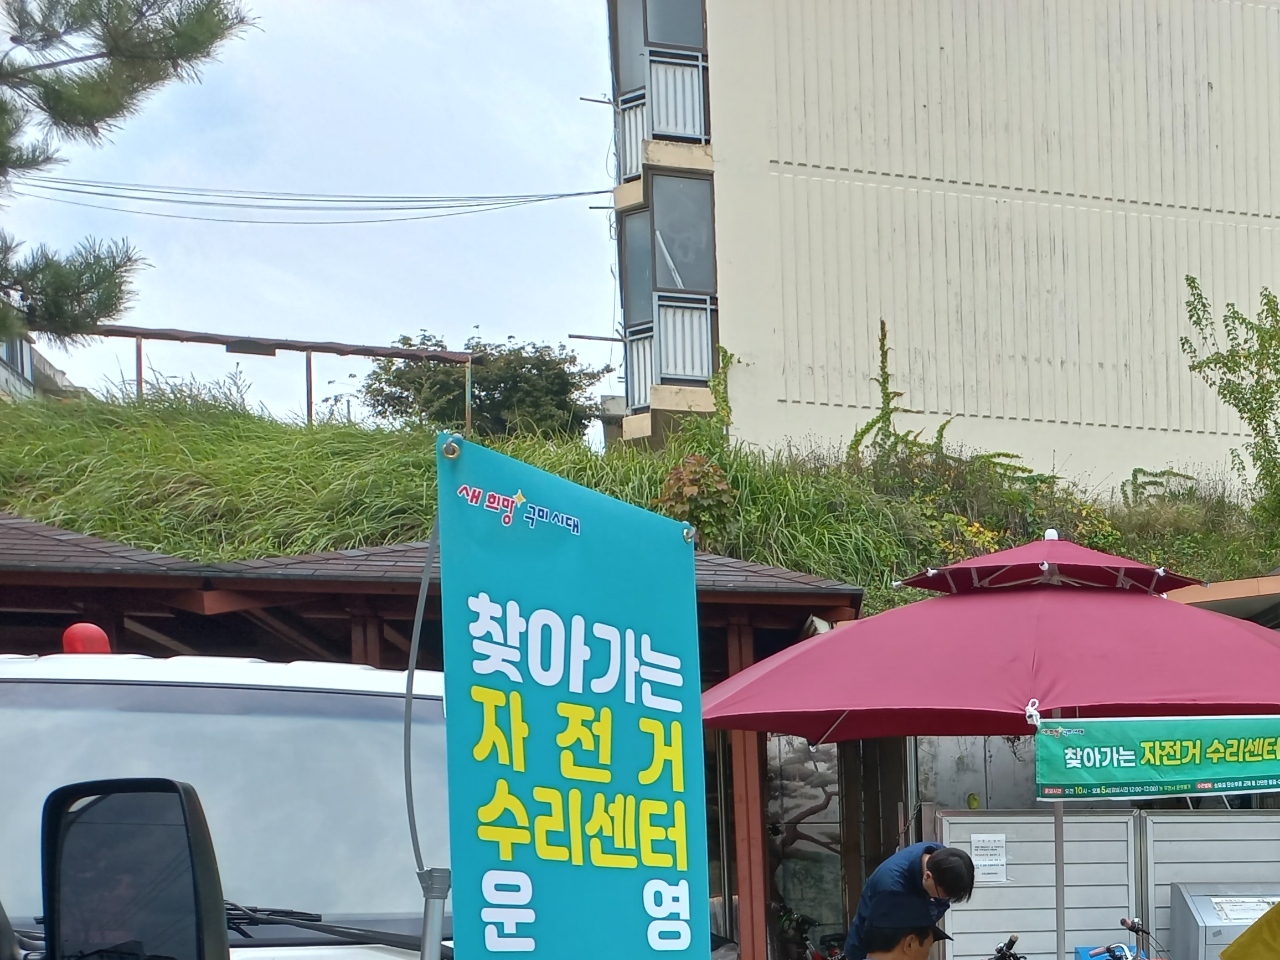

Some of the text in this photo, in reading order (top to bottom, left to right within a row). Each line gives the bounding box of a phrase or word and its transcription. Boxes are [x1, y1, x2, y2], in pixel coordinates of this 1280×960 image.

[468, 591, 683, 713] 찾아가는
[1064, 747, 1136, 769] 찾아가는
[1140, 739, 1201, 766] 자전거
[476, 779, 688, 871] 수리센터
